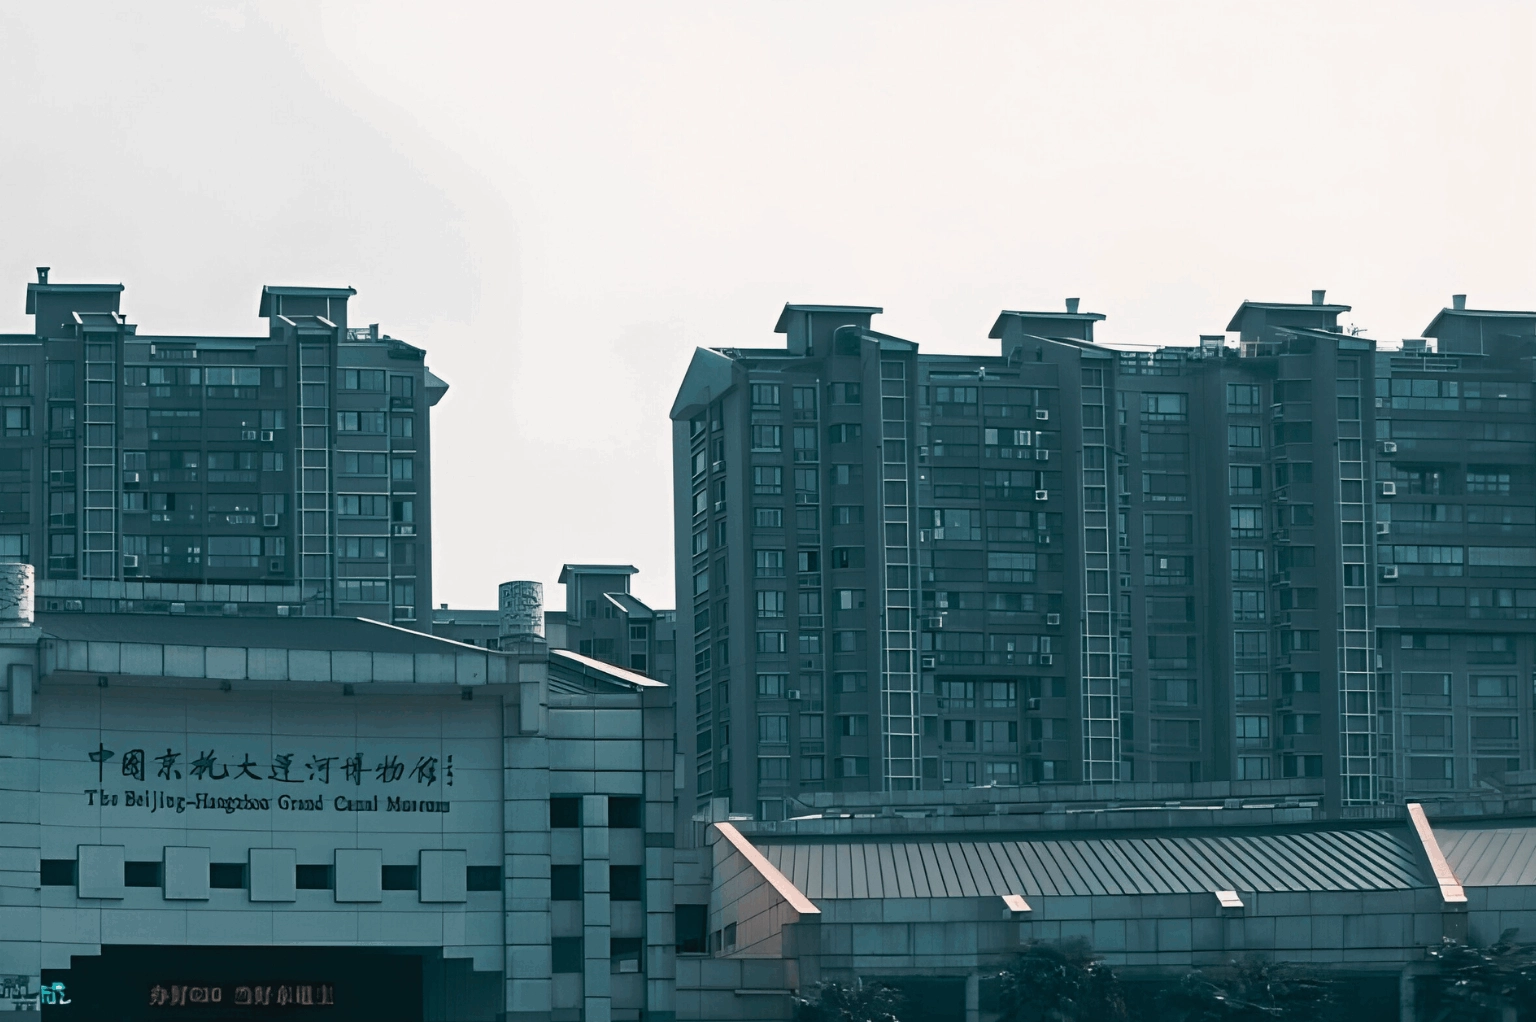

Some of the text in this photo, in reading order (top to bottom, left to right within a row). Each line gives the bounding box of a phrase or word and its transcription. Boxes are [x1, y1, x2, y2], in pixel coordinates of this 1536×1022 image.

[278, 793, 324, 812] Grand
[334, 795, 378, 812] Canal
[386, 796, 451, 813] Museum
